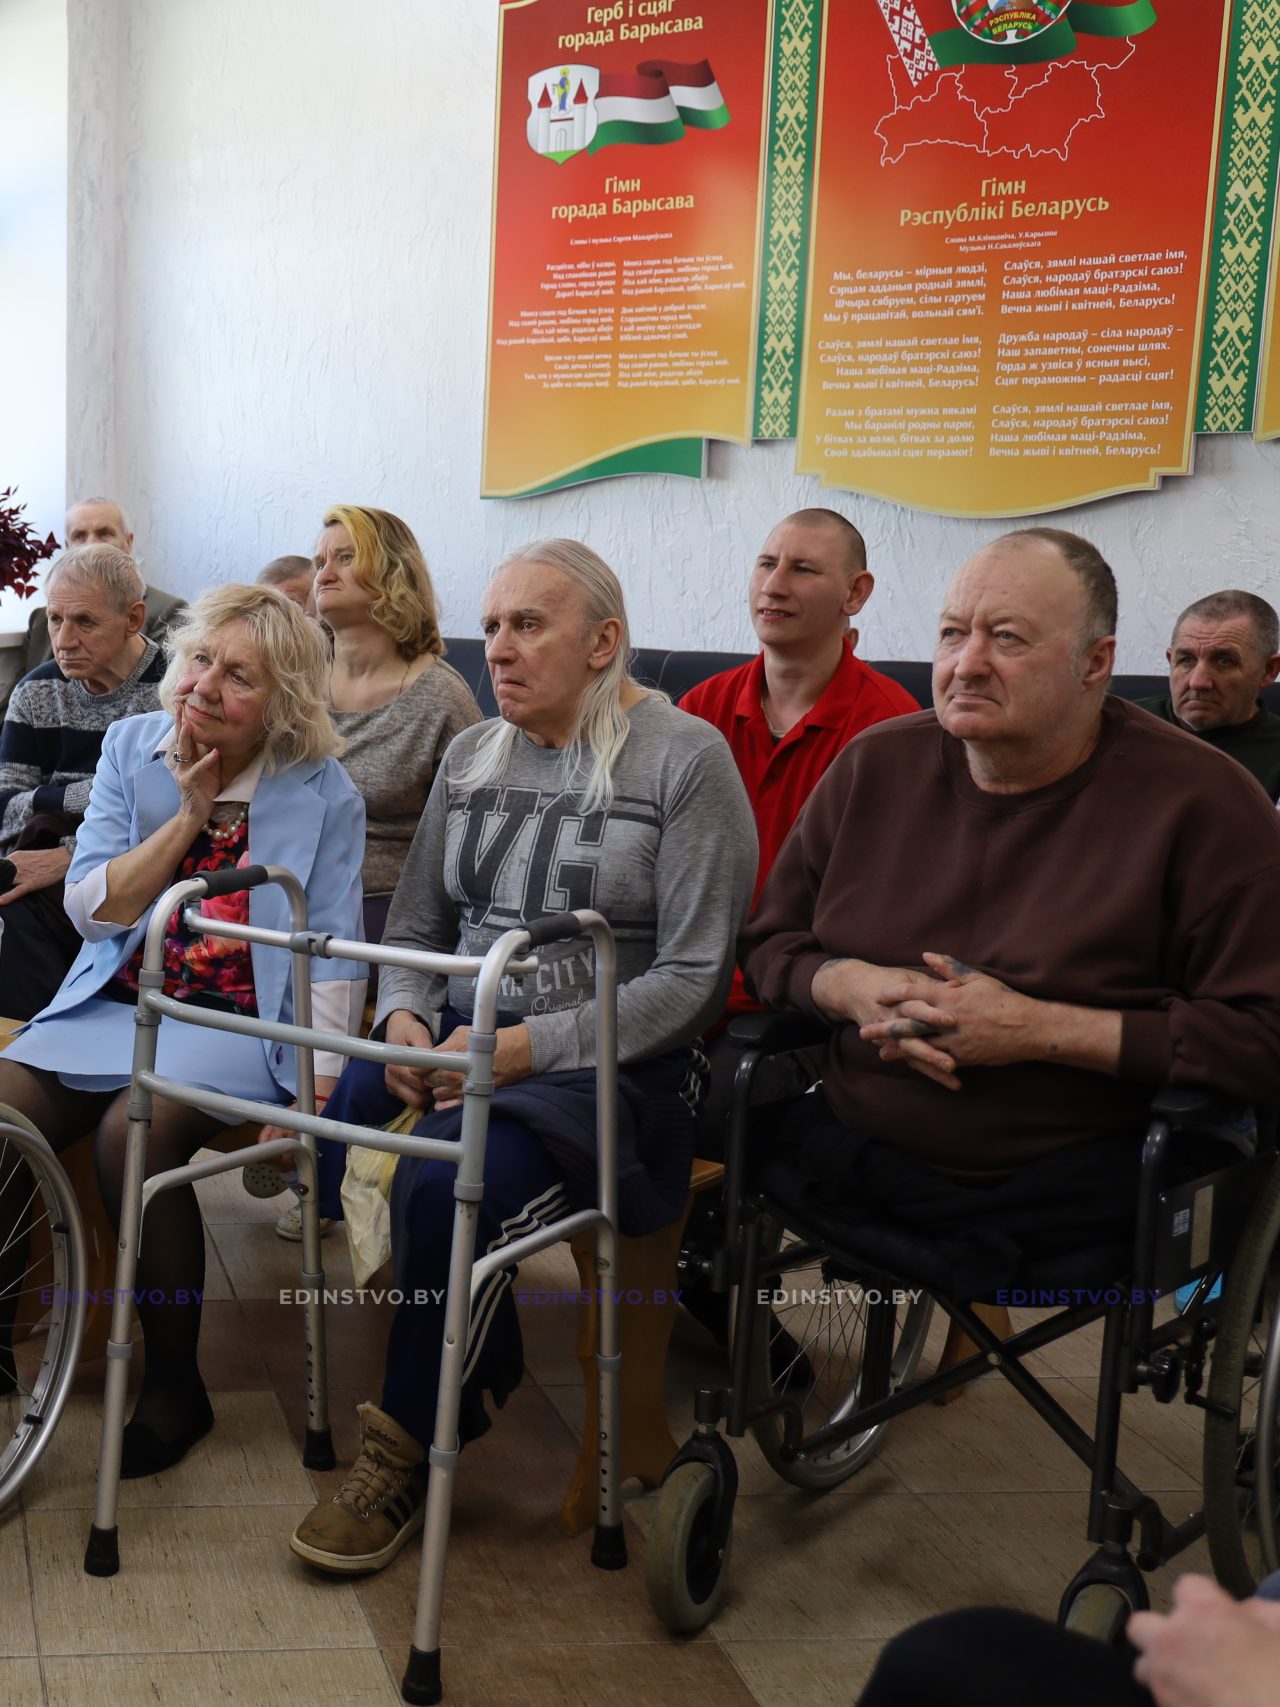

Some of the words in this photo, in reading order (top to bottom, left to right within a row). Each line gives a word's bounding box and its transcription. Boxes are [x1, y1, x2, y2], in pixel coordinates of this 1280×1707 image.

[587, 1, 623, 26] Герб
[628, 0, 633, 18] і
[638, 0, 676, 17] сцяг
[989, 12, 1037, 27] РЭСПУБЛІКА
[558, 28, 614, 52] горада
[620, 16, 703, 42] Барысава
[992, 21, 1033, 35] БЕЛАРУСЬ
[605, 176, 640, 194] Гімн
[981, 178, 1026, 198] Гімн
[552, 203, 607, 223] горада
[612, 195, 695, 218] Барысава
[900, 200, 1004, 229] Рэспублікі
[1011, 197, 1109, 220] Беларусь
[1046, 255, 1076, 267] зямлі
[1078, 253, 1115, 265] нашай
[1118, 252, 1162, 262] светлае
[1045, 269, 1091, 284] народаў
[1093, 266, 1148, 281] братэрскі
[1150, 263, 1183, 275] саюз!
[1001, 289, 1031, 299] Наша
[1033, 286, 1080, 297] любімая
[1000, 304, 1032, 314] Вечна
[1035, 300, 1064, 312] жыві
[1119, 294, 1175, 308] Беларусь!
[998, 331, 1040, 345] Дружба
[1042, 328, 1088, 342] народаў
[1100, 327, 1123, 338] сіла
[1126, 324, 1174, 338] народаў
[997, 347, 1020, 357] Наш
[1086, 343, 1135, 353] сонечны
[996, 361, 1026, 373] Горда
[1040, 359, 1073, 372] узвіся
[1085, 359, 1119, 368] ясныя
[994, 376, 1019, 387] Сцяг
[1021, 375, 1087, 386] пераможны
[1098, 370, 1142, 384] радасці
[1144, 369, 1174, 382] сцяг!
[1034, 402, 1063, 413] зямлі
[1066, 401, 1102, 412] нашай
[1105, 402, 1148, 411] светлае
[1032, 416, 1078, 429] народаў
[1080, 415, 1134, 428] братэрскі
[1136, 414, 1169, 425] саюз!
[990, 432, 1019, 442] Наша
[1021, 431, 1067, 441] любімая
[989, 446, 1020, 456] Вечна
[1022, 445, 1050, 455] жыві
[1105, 444, 1161, 457] Беларусь!
[536, 948, 595, 994] CITY
[530, 989, 584, 1016] Original
[367, 1425, 399, 1447] adidas
